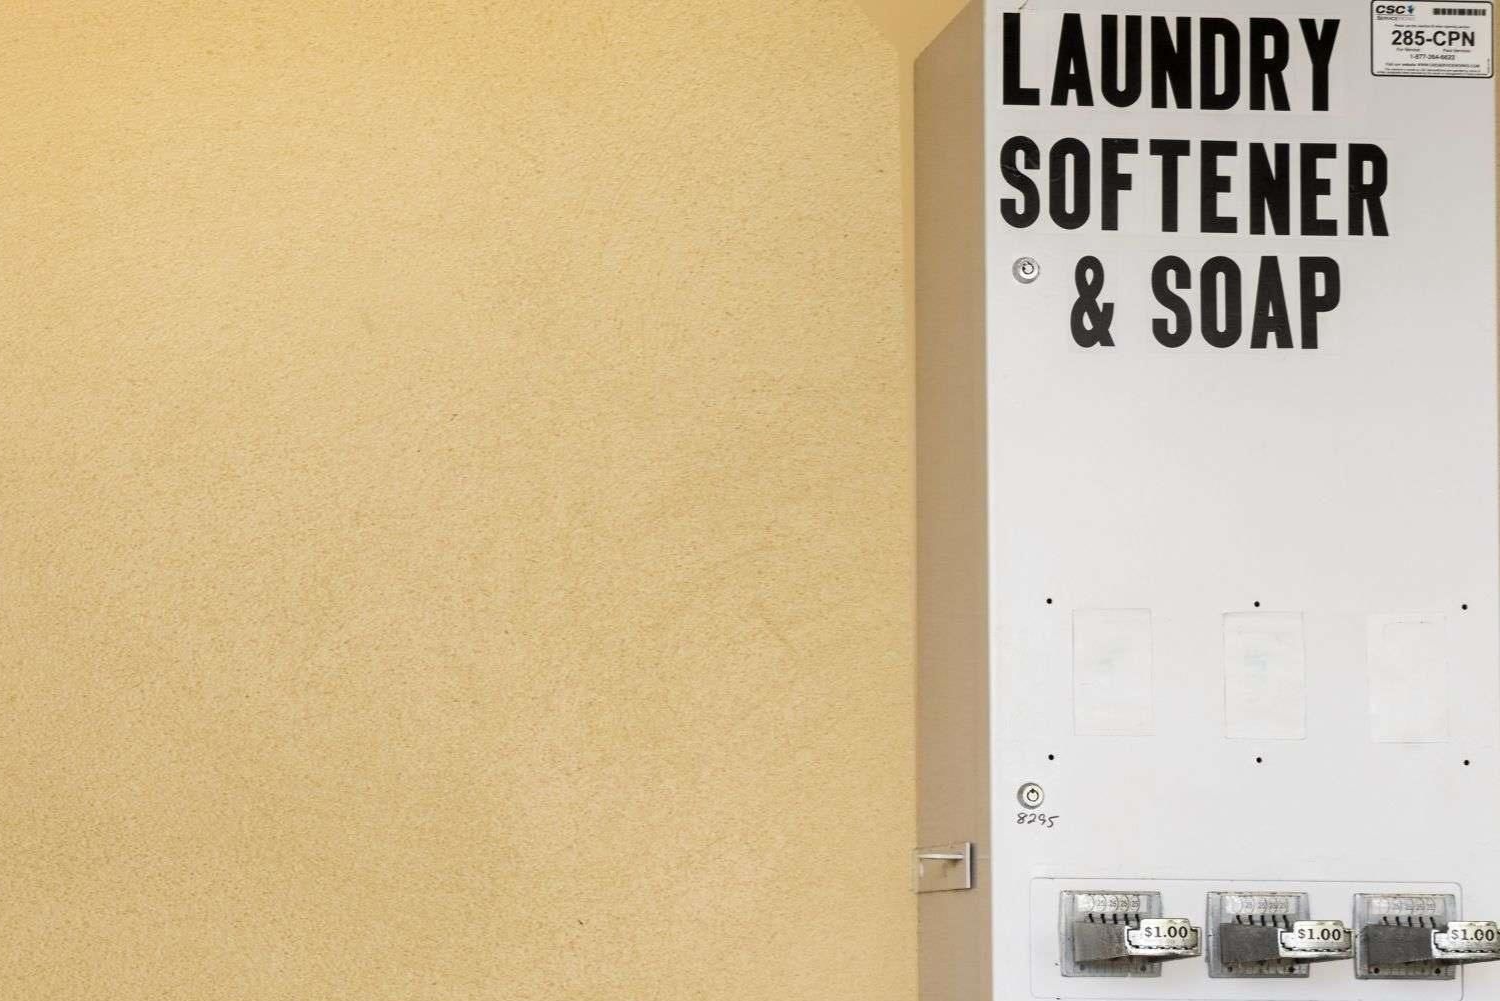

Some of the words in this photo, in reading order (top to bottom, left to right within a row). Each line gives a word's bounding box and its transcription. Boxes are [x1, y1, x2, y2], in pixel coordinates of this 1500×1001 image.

[1375, 5, 1406, 15] CSC
[1391, 30, 1475, 47] 285-CPN
[1002, 12, 1341, 112] LAUNDRY
[1000, 135, 1389, 237] SOFTENER
[1069, 255, 1116, 348] &
[1151, 255, 1341, 350] SOAP
[1017, 812, 1060, 828] 8295
[1144, 926, 1188, 939] $1.00
[1298, 928, 1342, 941] $1.00
[1451, 928, 1495, 941] $1.00
